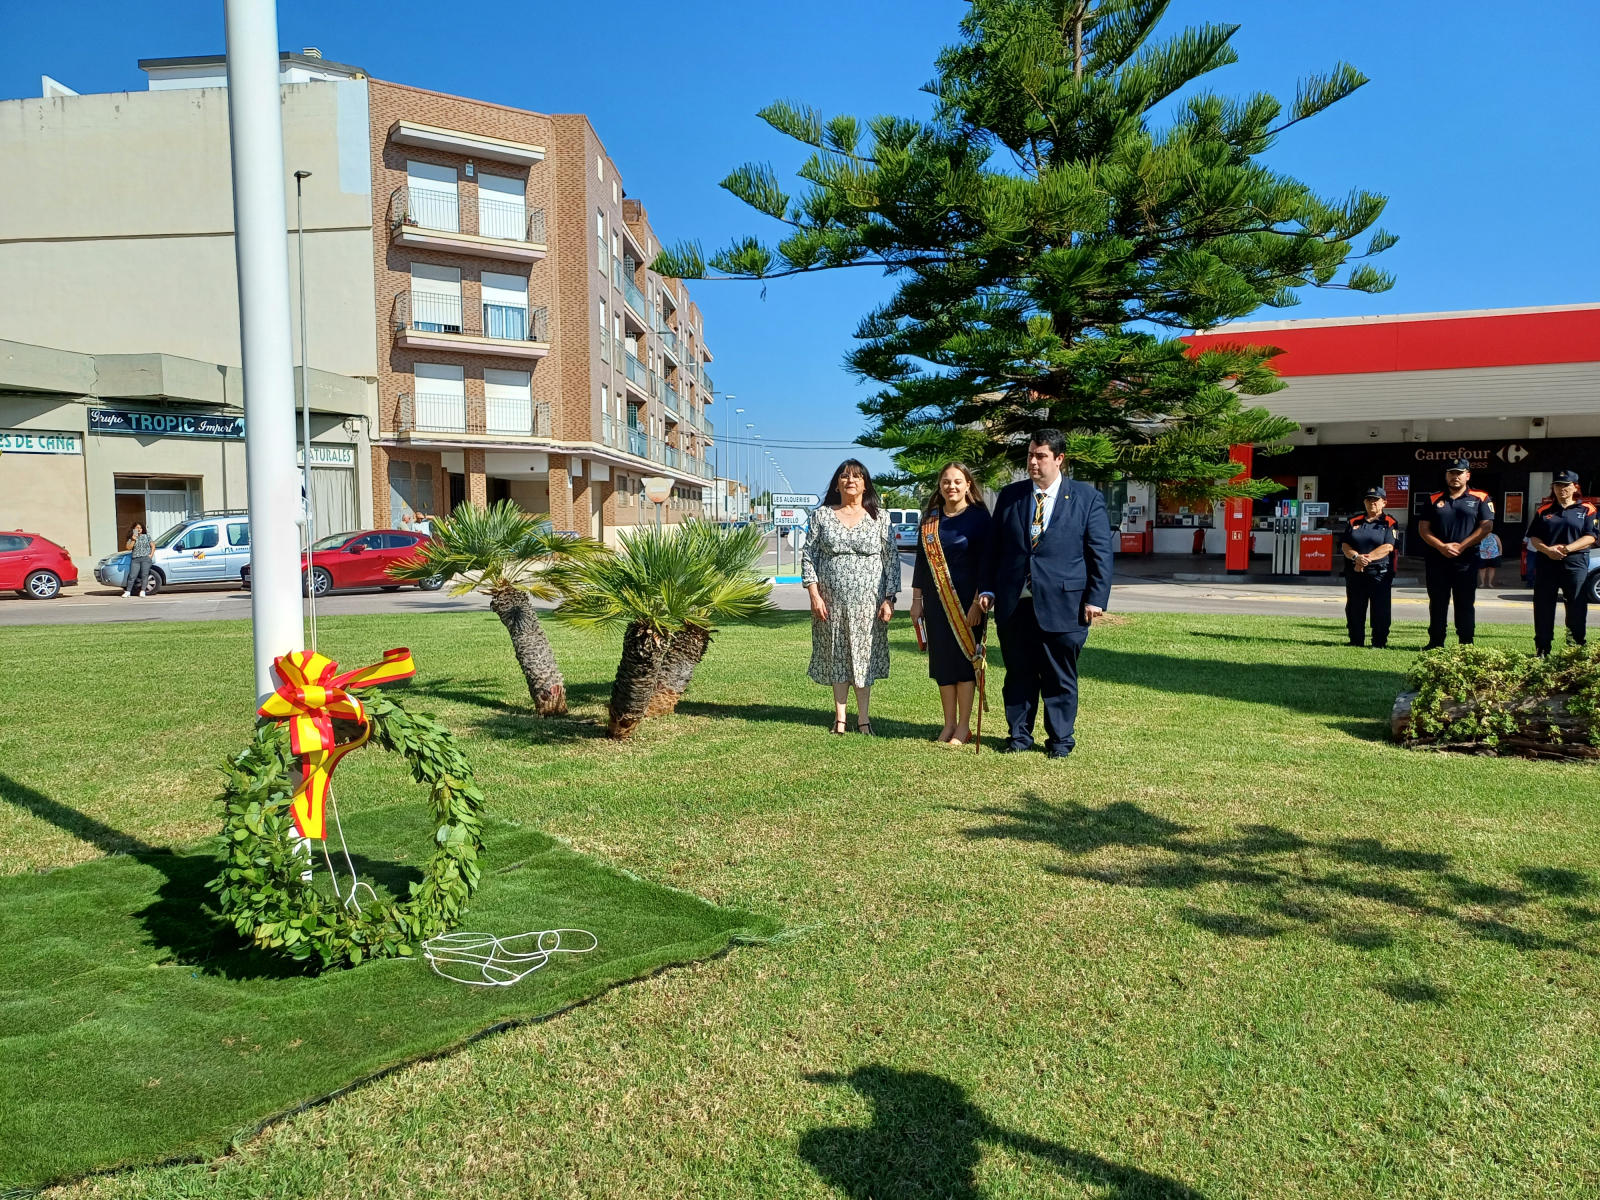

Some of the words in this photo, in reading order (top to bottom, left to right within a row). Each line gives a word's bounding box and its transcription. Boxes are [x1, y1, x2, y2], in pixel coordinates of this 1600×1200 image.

[91, 410, 124, 426] Grupo
[128, 413, 195, 433] TROPIC
[198, 420, 234, 434] Import
[15, 433, 33, 449] DE
[38, 433, 75, 451] CAÑA
[1415, 447, 1490, 460] Carrefour
